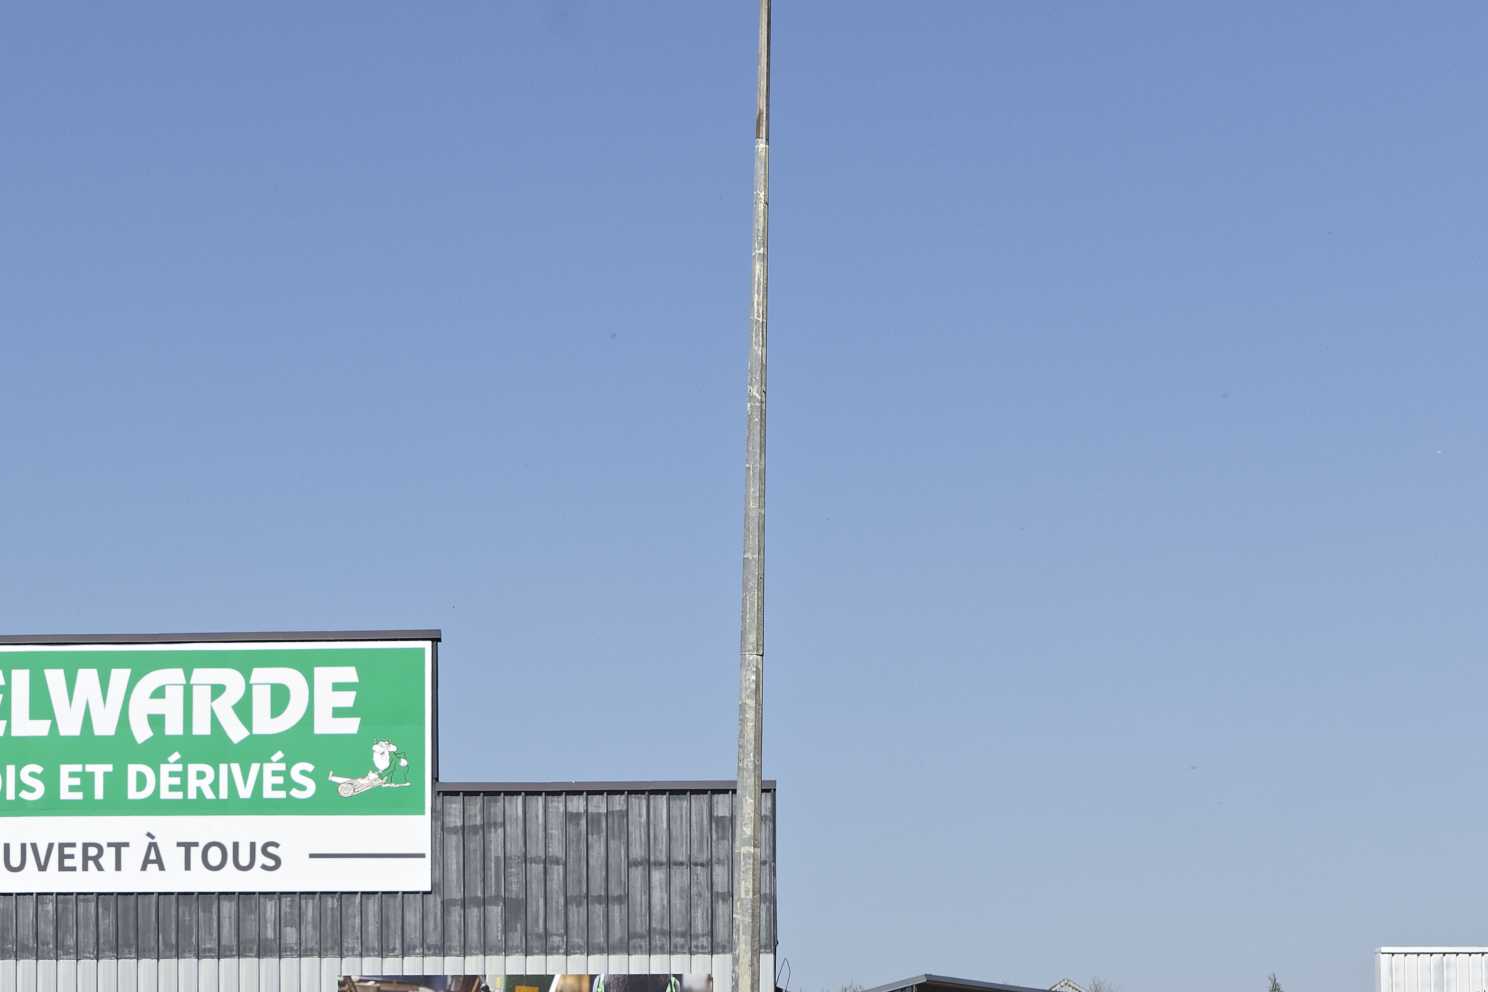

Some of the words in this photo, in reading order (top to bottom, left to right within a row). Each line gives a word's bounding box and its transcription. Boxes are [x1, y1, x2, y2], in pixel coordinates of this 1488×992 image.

[59, 763, 114, 801] ET
[127, 750, 317, 800] DÉRIVÉS
[139, 831, 166, 872] À
[176, 840, 282, 872] TOUS
